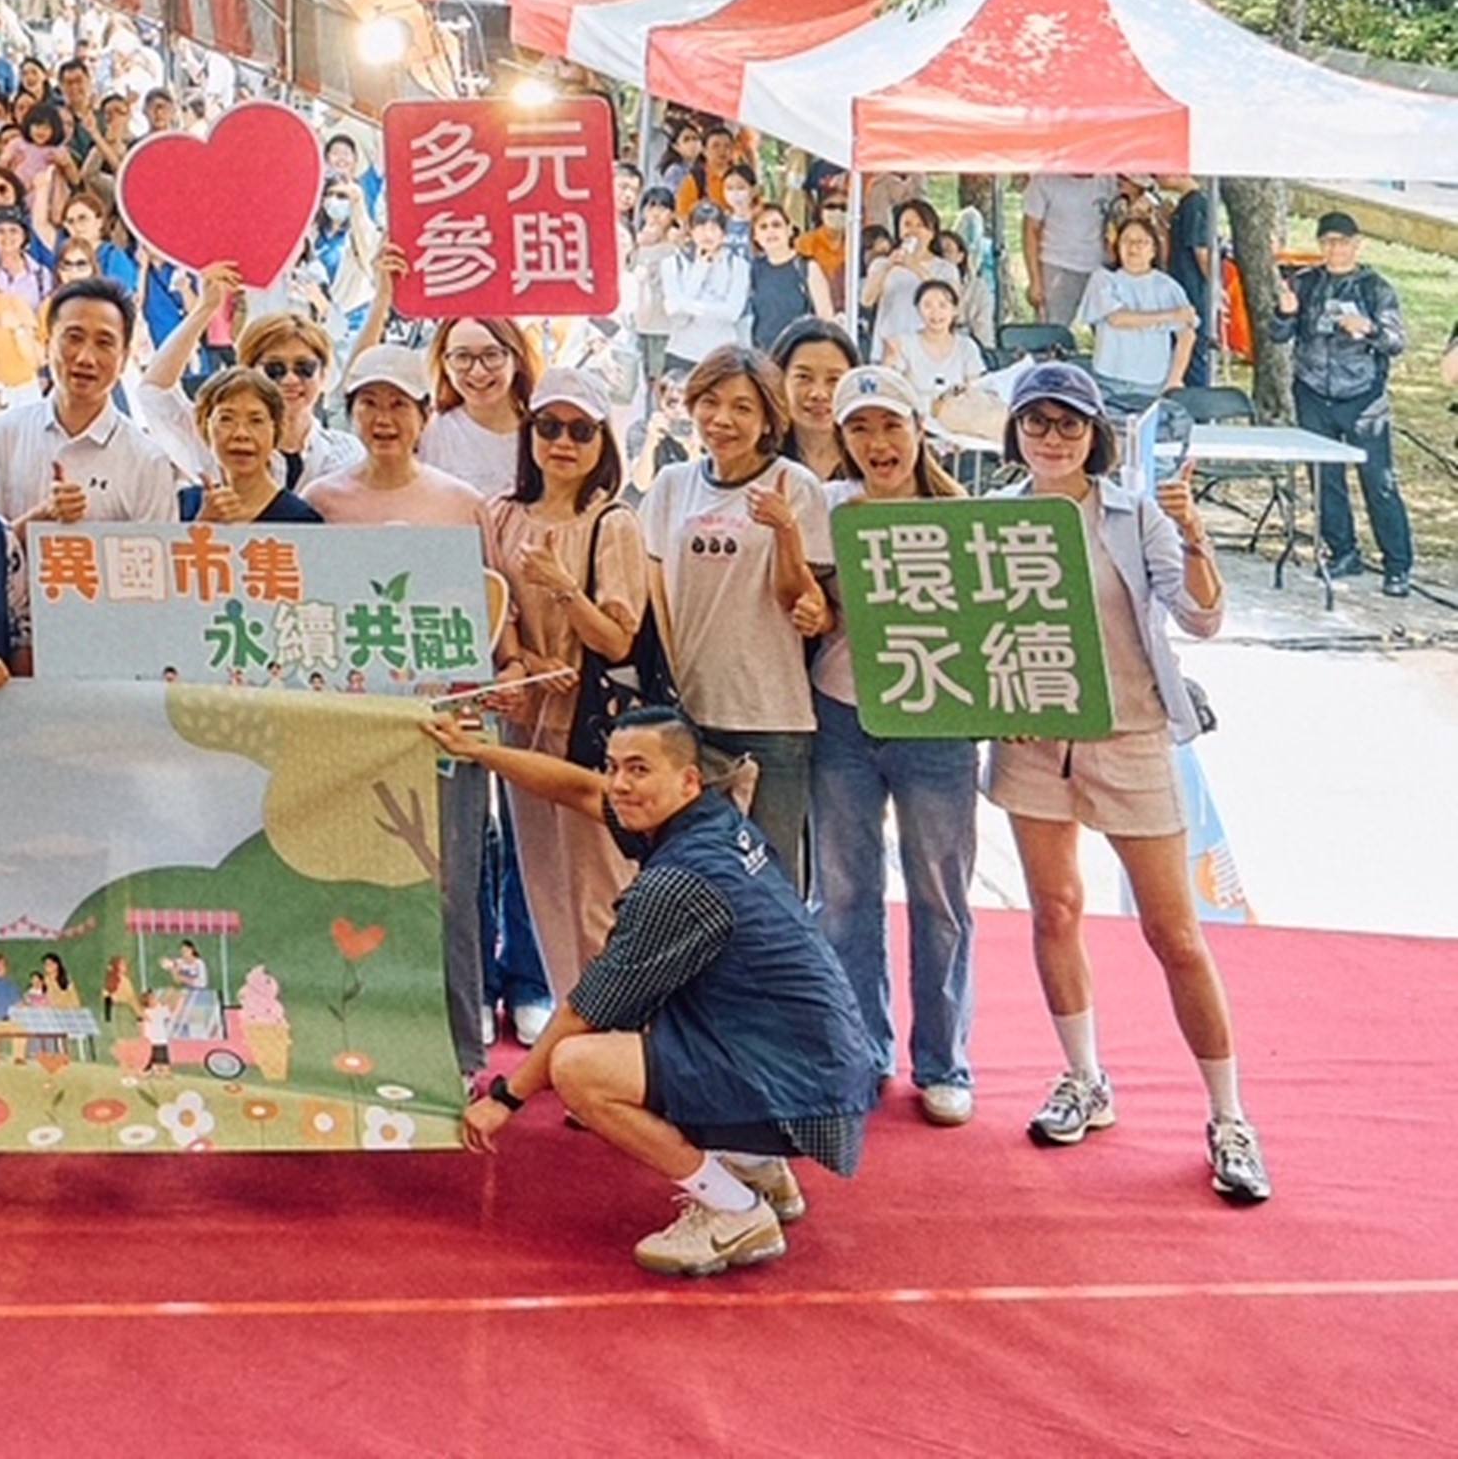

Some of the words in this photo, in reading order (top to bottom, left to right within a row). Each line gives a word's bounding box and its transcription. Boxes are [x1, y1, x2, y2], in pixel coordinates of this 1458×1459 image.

[410, 119, 591, 204] 多元
[413, 210, 594, 298] 參與
[38, 526, 302, 604] 異國市集
[856, 519, 1069, 614] 環境
[204, 598, 479, 671] 永續共融
[876, 619, 1081, 715] 永續
